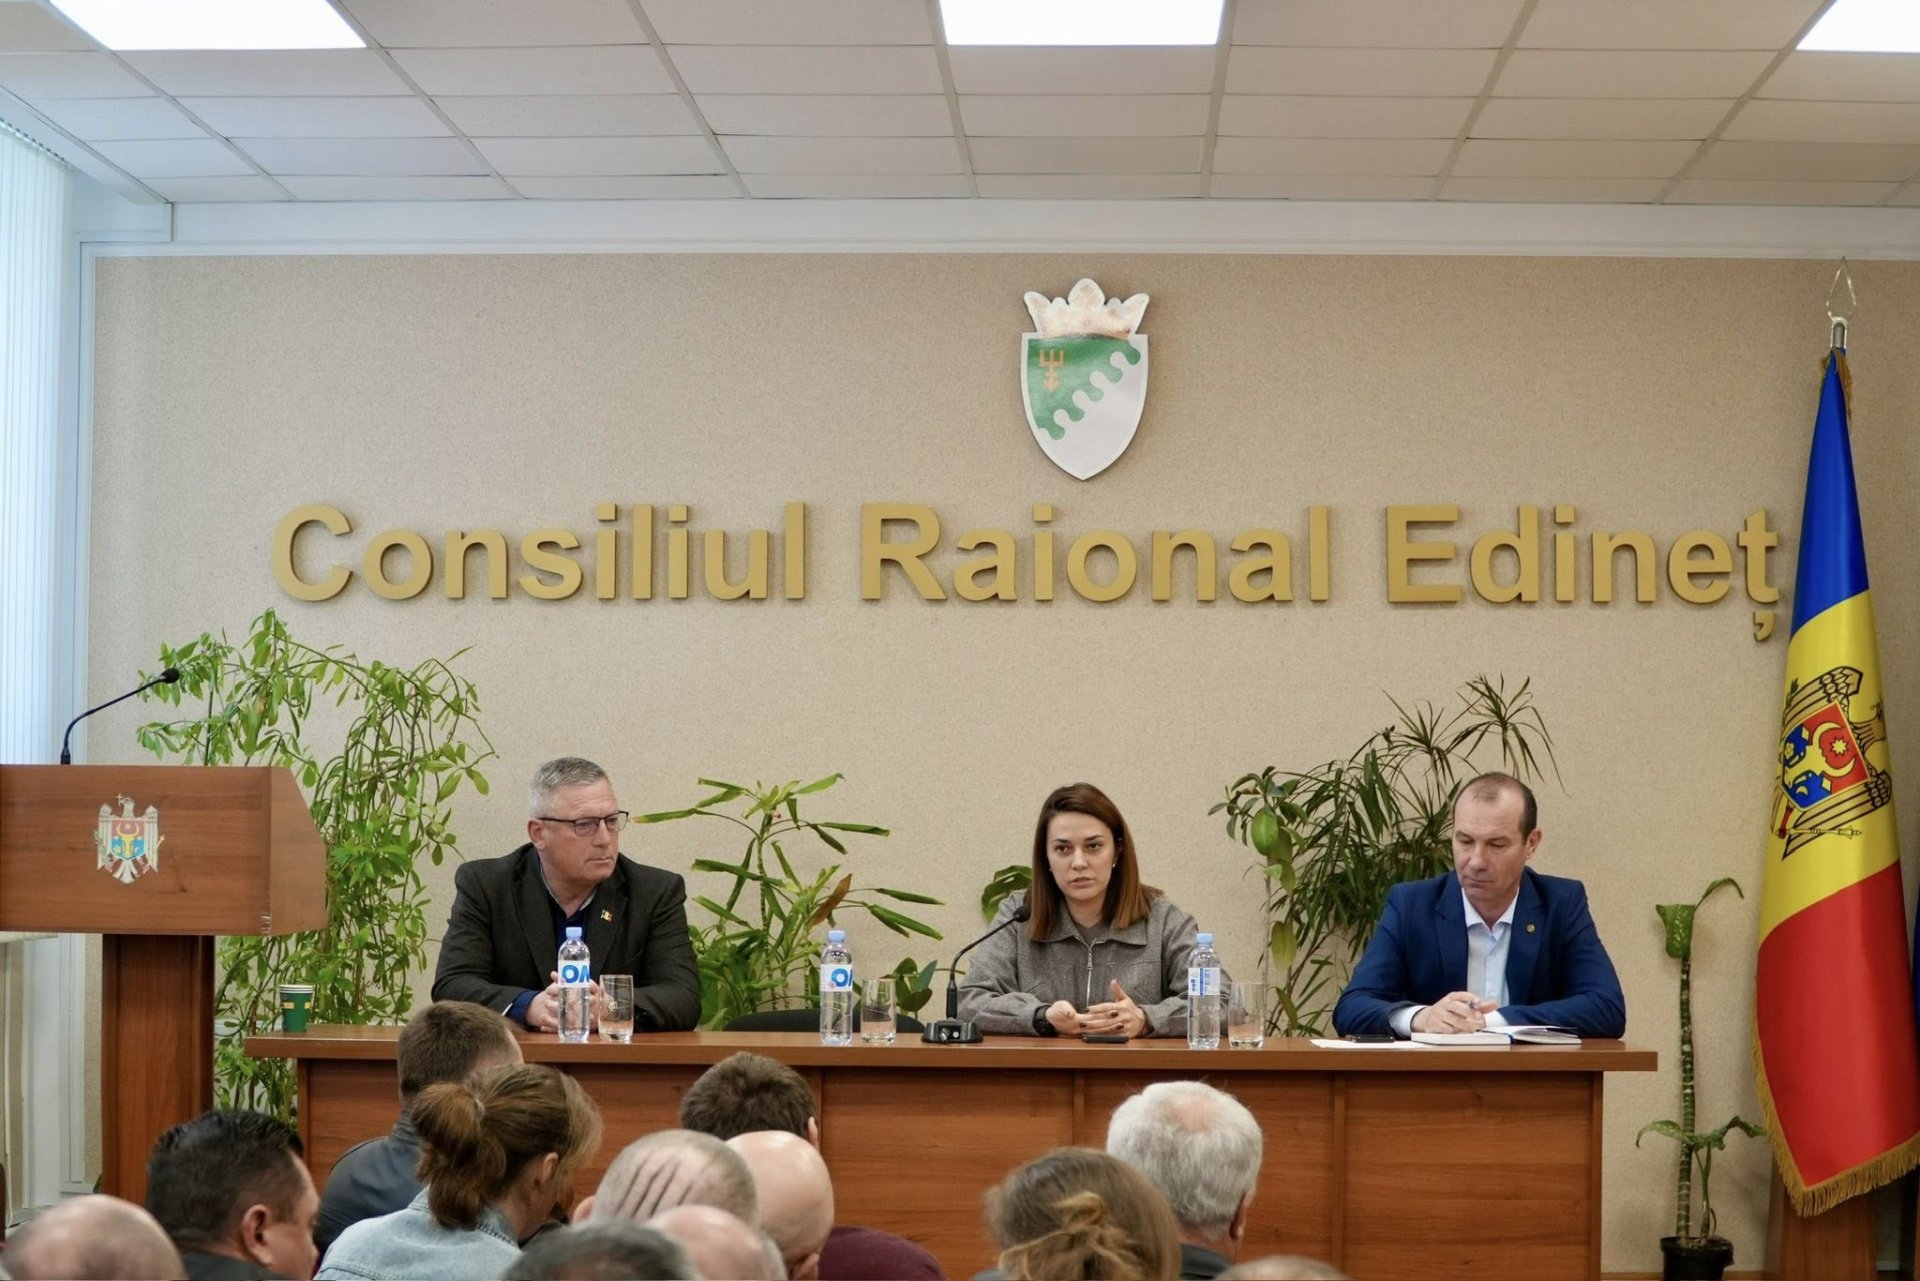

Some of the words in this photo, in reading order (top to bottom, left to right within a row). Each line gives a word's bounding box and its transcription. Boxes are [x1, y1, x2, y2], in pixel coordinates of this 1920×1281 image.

[271, 502, 806, 602] Consiliul
[861, 503, 1330, 603] Raional
[1386, 505, 1780, 642] Edineț
